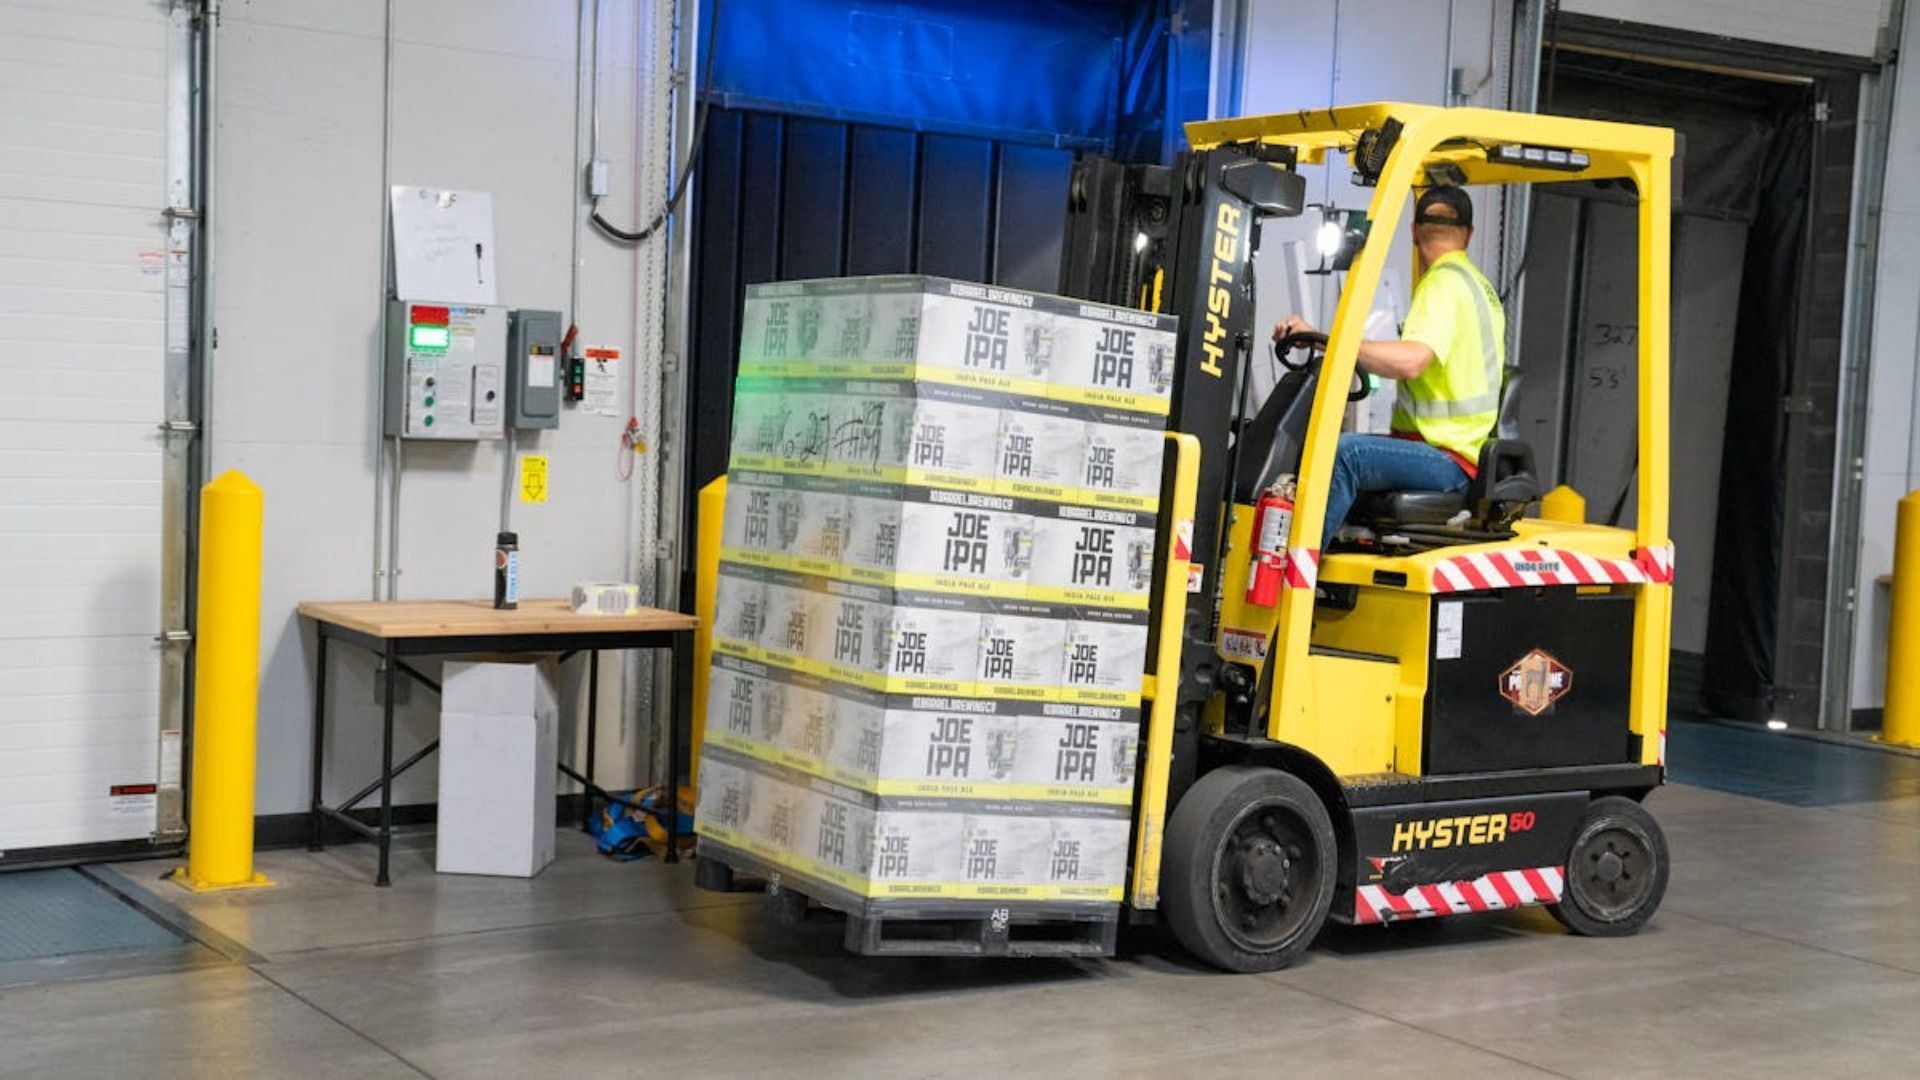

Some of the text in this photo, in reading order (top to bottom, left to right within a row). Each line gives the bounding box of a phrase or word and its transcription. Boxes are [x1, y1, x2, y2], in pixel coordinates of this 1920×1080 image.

[1200, 203, 1241, 377] HYSTER
[968, 306, 1010, 336] JOE
[964, 334, 1008, 370] IPA
[1096, 327, 1136, 356] JOE
[1092, 352, 1133, 389] IPA
[1084, 391, 1136, 405] INDIA PALE ALE
[916, 424, 946, 443] JOE
[1005, 435, 1034, 453] JOE
[914, 443, 944, 467] IPA
[1003, 453, 1031, 477] IPA
[1089, 446, 1116, 465] JOE
[1086, 464, 1114, 488] IPA
[747, 491, 770, 514] JOE
[744, 515, 768, 547] IPA
[948, 512, 990, 540] JOE
[1075, 527, 1115, 553] JOE
[943, 539, 988, 574] IPA
[1072, 553, 1112, 586] IPA
[837, 602, 864, 629] JOE
[834, 629, 862, 664] IPA
[897, 632, 927, 650] JOE
[986, 639, 1015, 656] JOE
[1071, 644, 1098, 662] JOE
[895, 650, 926, 674] IPA
[984, 656, 1014, 679] IPA
[1068, 662, 1096, 684] IPA
[731, 677, 754, 702] JOE
[729, 702, 751, 735] IPA
[930, 717, 973, 744] JOE
[1059, 724, 1100, 749] JOE
[926, 743, 971, 777] IPA
[1055, 749, 1097, 781] IPA
[1392, 811, 1535, 852] HYSTER 50
[881, 836, 910, 854] JOE
[969, 839, 998, 856] JOE
[1054, 841, 1081, 858] JOE
[878, 855, 908, 877] IPA
[967, 857, 996, 880] IPA
[1051, 859, 1079, 880] IPA
[991, 909, 1009, 920] AB
